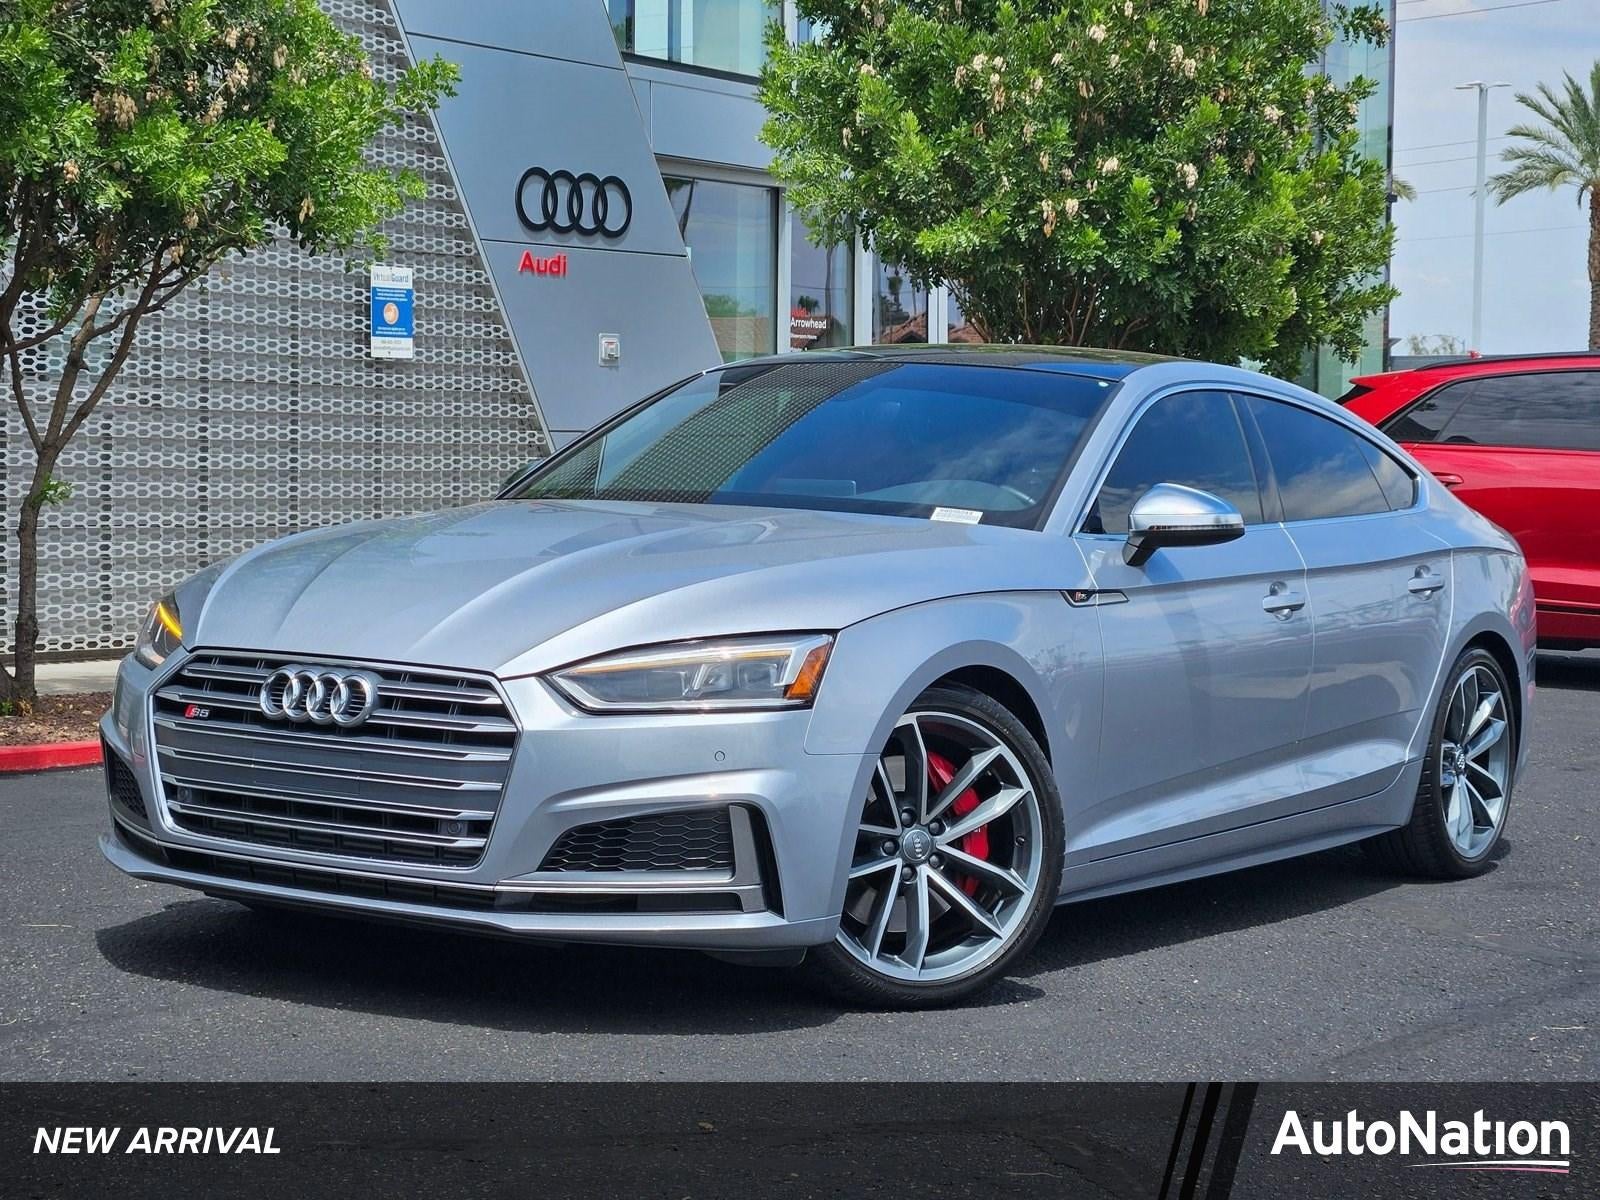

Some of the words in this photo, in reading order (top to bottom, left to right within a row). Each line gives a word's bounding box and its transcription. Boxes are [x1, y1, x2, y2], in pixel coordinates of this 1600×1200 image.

[518, 249, 568, 277] Audi
[790, 317, 827, 329] Arrowhead
[188, 705, 210, 718] S5
